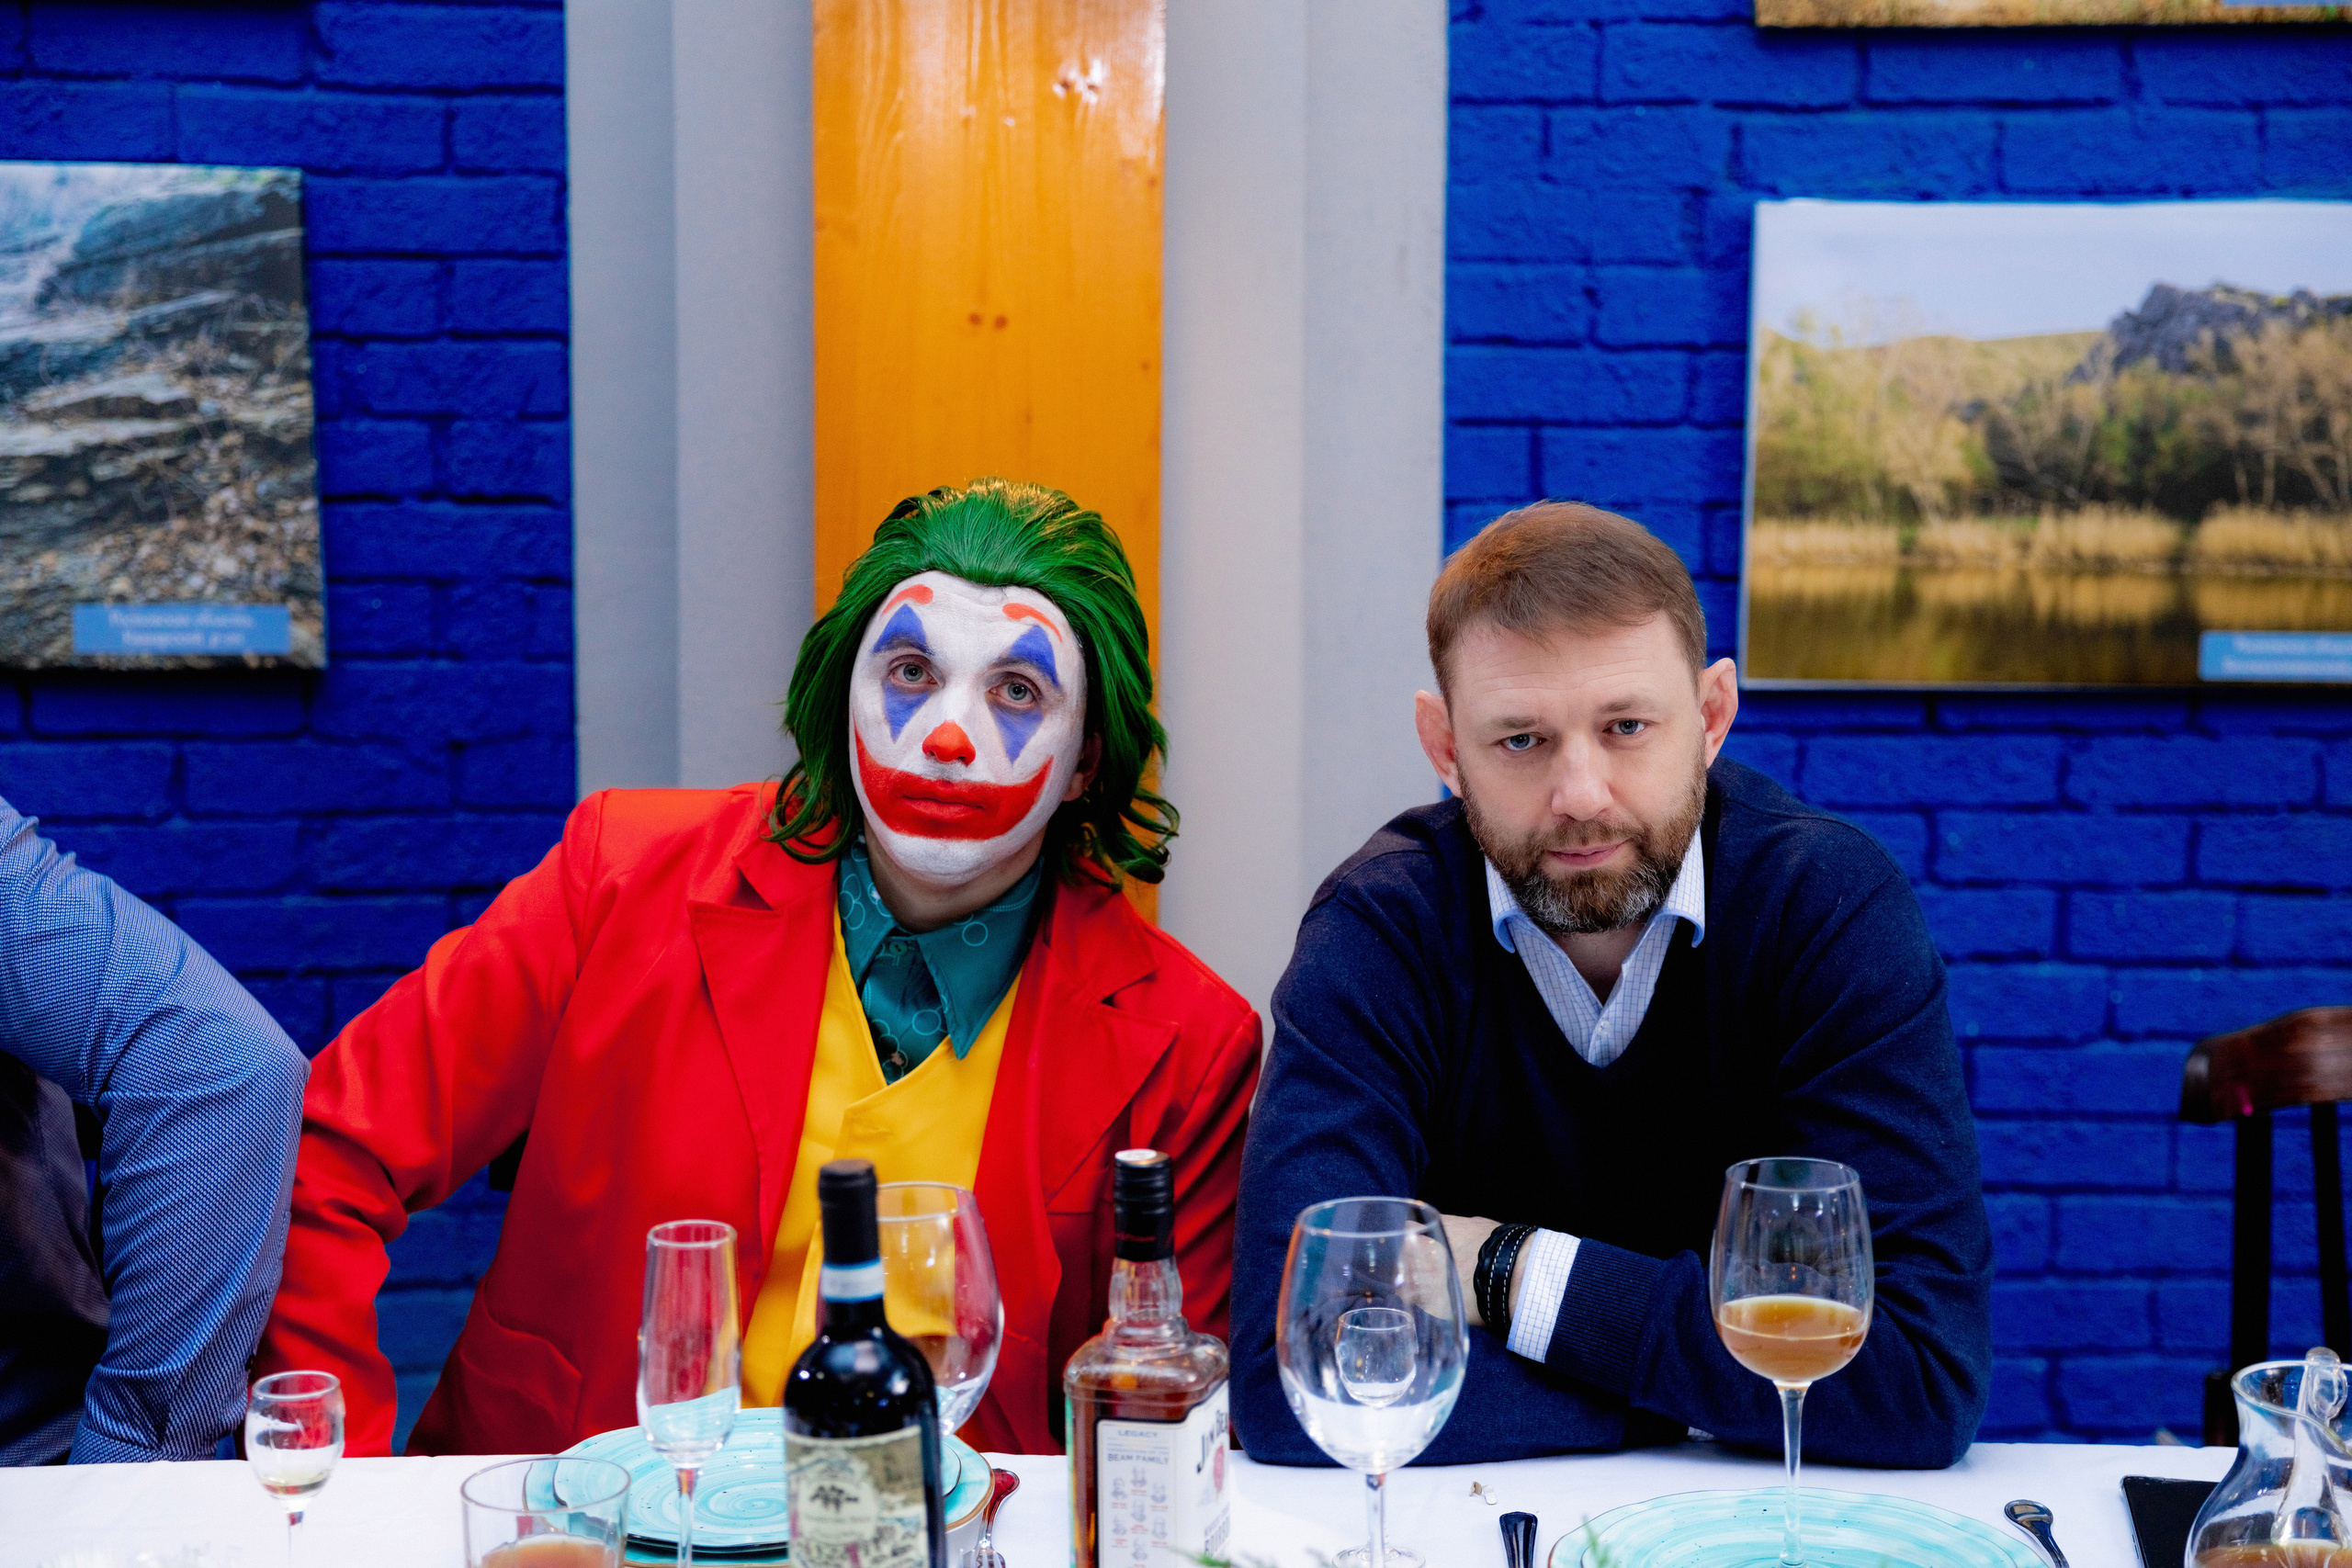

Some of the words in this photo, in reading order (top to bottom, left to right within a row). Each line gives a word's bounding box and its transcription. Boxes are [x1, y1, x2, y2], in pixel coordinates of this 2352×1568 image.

[1117, 1429, 1158, 1438] LEGACY
[1107, 1453, 1133, 1461] BEAM
[1136, 1455, 1170, 1465] FAMILY
